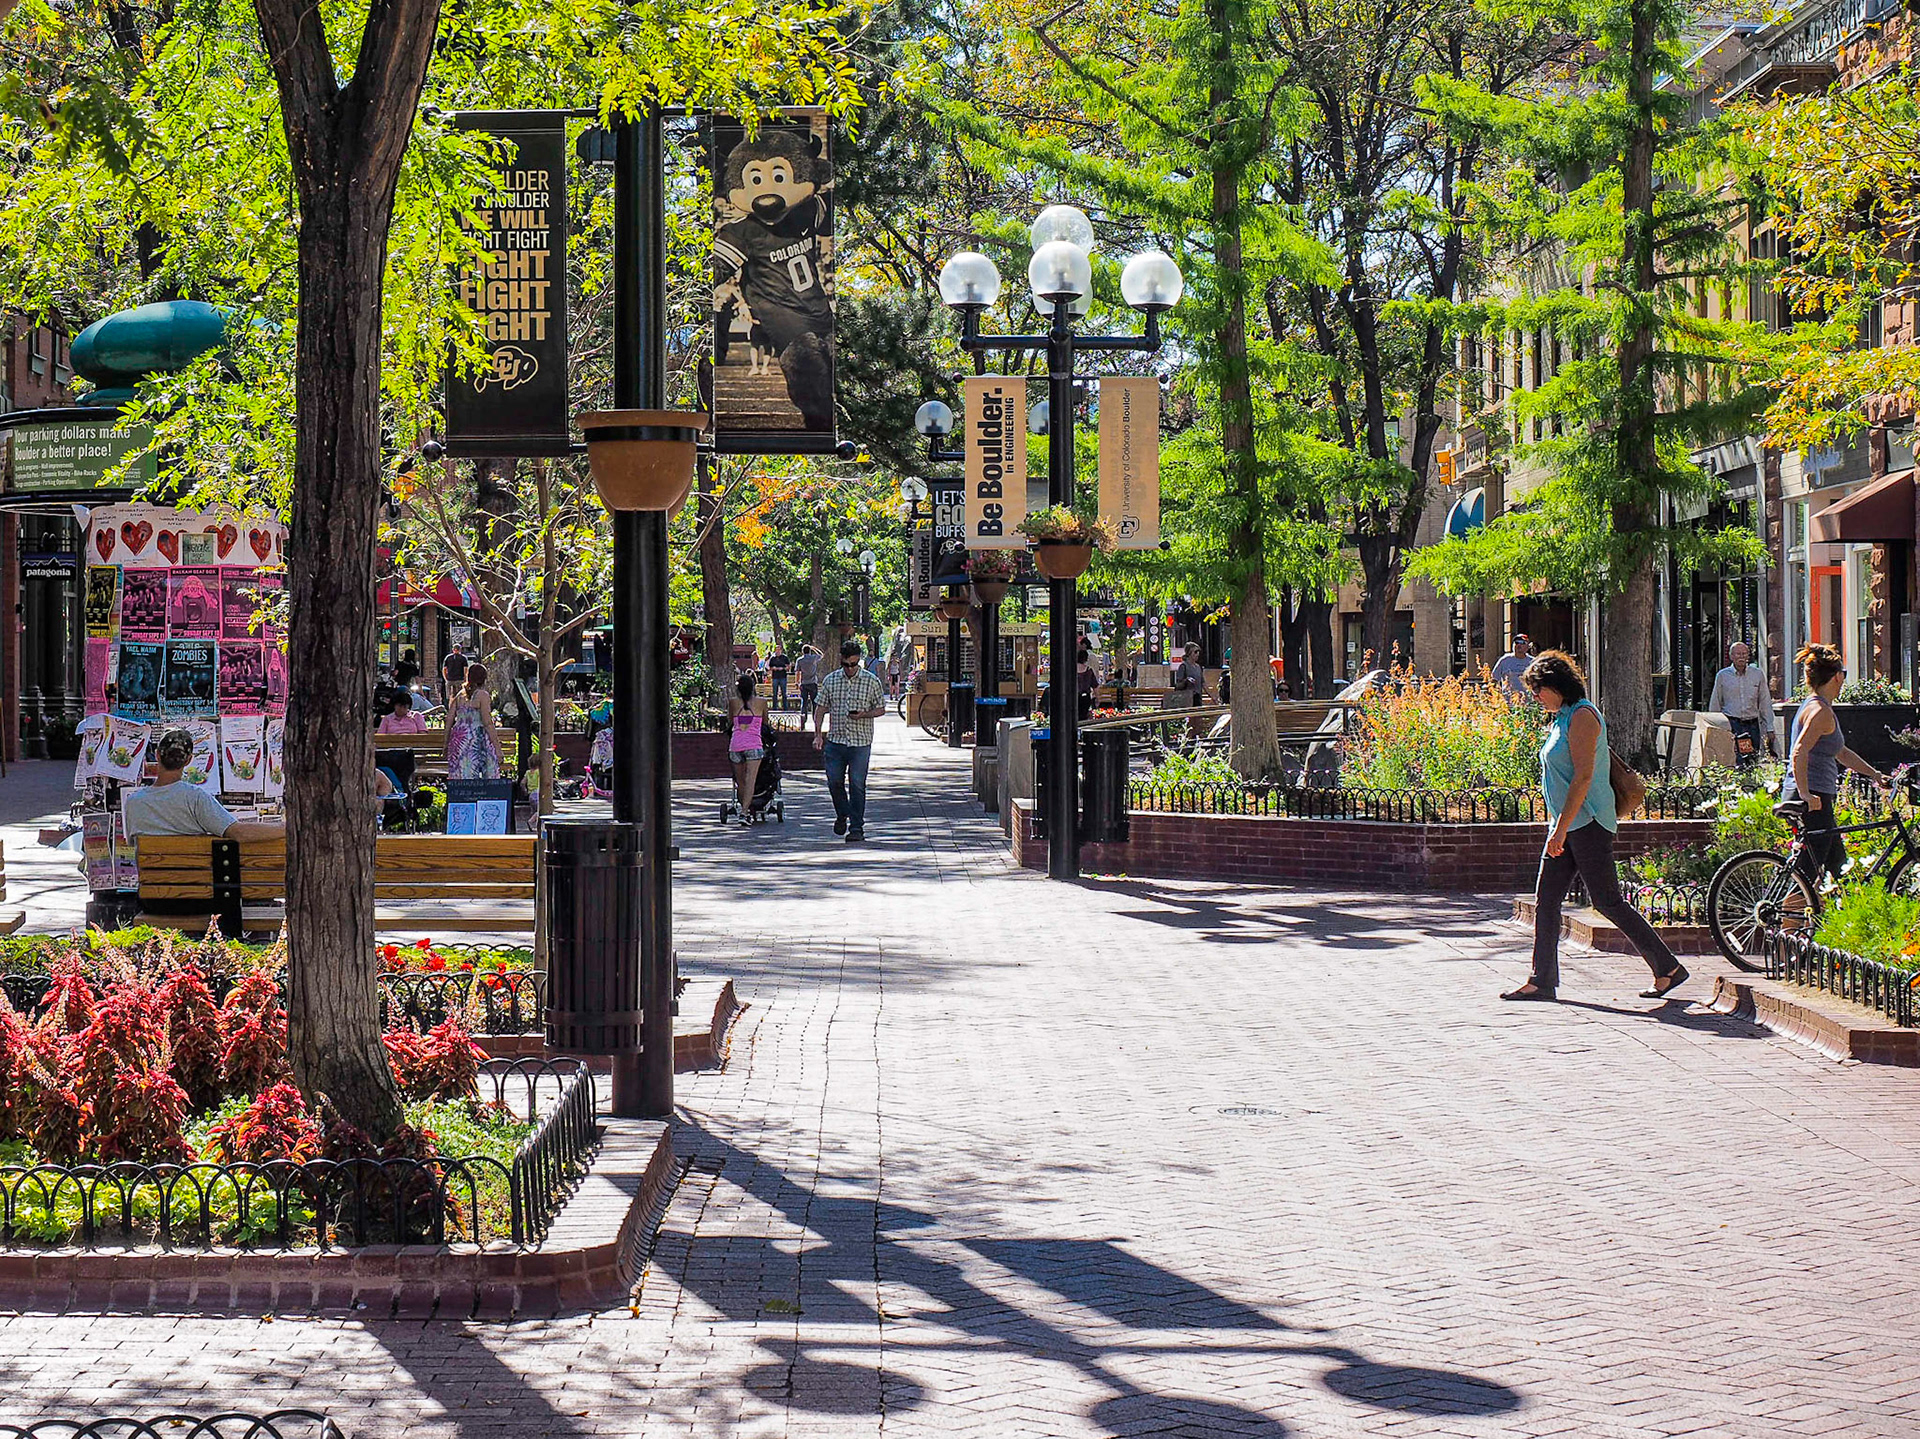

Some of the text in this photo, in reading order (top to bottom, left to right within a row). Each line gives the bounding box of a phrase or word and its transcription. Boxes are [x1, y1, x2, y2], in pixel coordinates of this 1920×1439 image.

[500, 210, 550, 228] WILL
[507, 231, 550, 248] FIGHT
[460, 281, 550, 310] FIGHT
[477, 312, 550, 340] GHT
[1123, 388, 1131, 423] Boulder
[14, 430, 28, 442] Your
[30, 427, 59, 444] parking
[61, 426, 96, 439] dollars
[1005, 397, 1014, 473] In ENGINEERING
[1122, 424, 1131, 461] Colorado
[15, 443, 112, 460] Boulder a better place!
[977, 388, 1002, 536] Be Boulder.
[936, 490, 965, 505] LET'S
[1123, 474, 1131, 511] University
[935, 505, 965, 526] GO
[26, 568, 71, 577] patagonia
[921, 624, 942, 633] Sun
[172, 650, 207, 660] ZOMBIES
